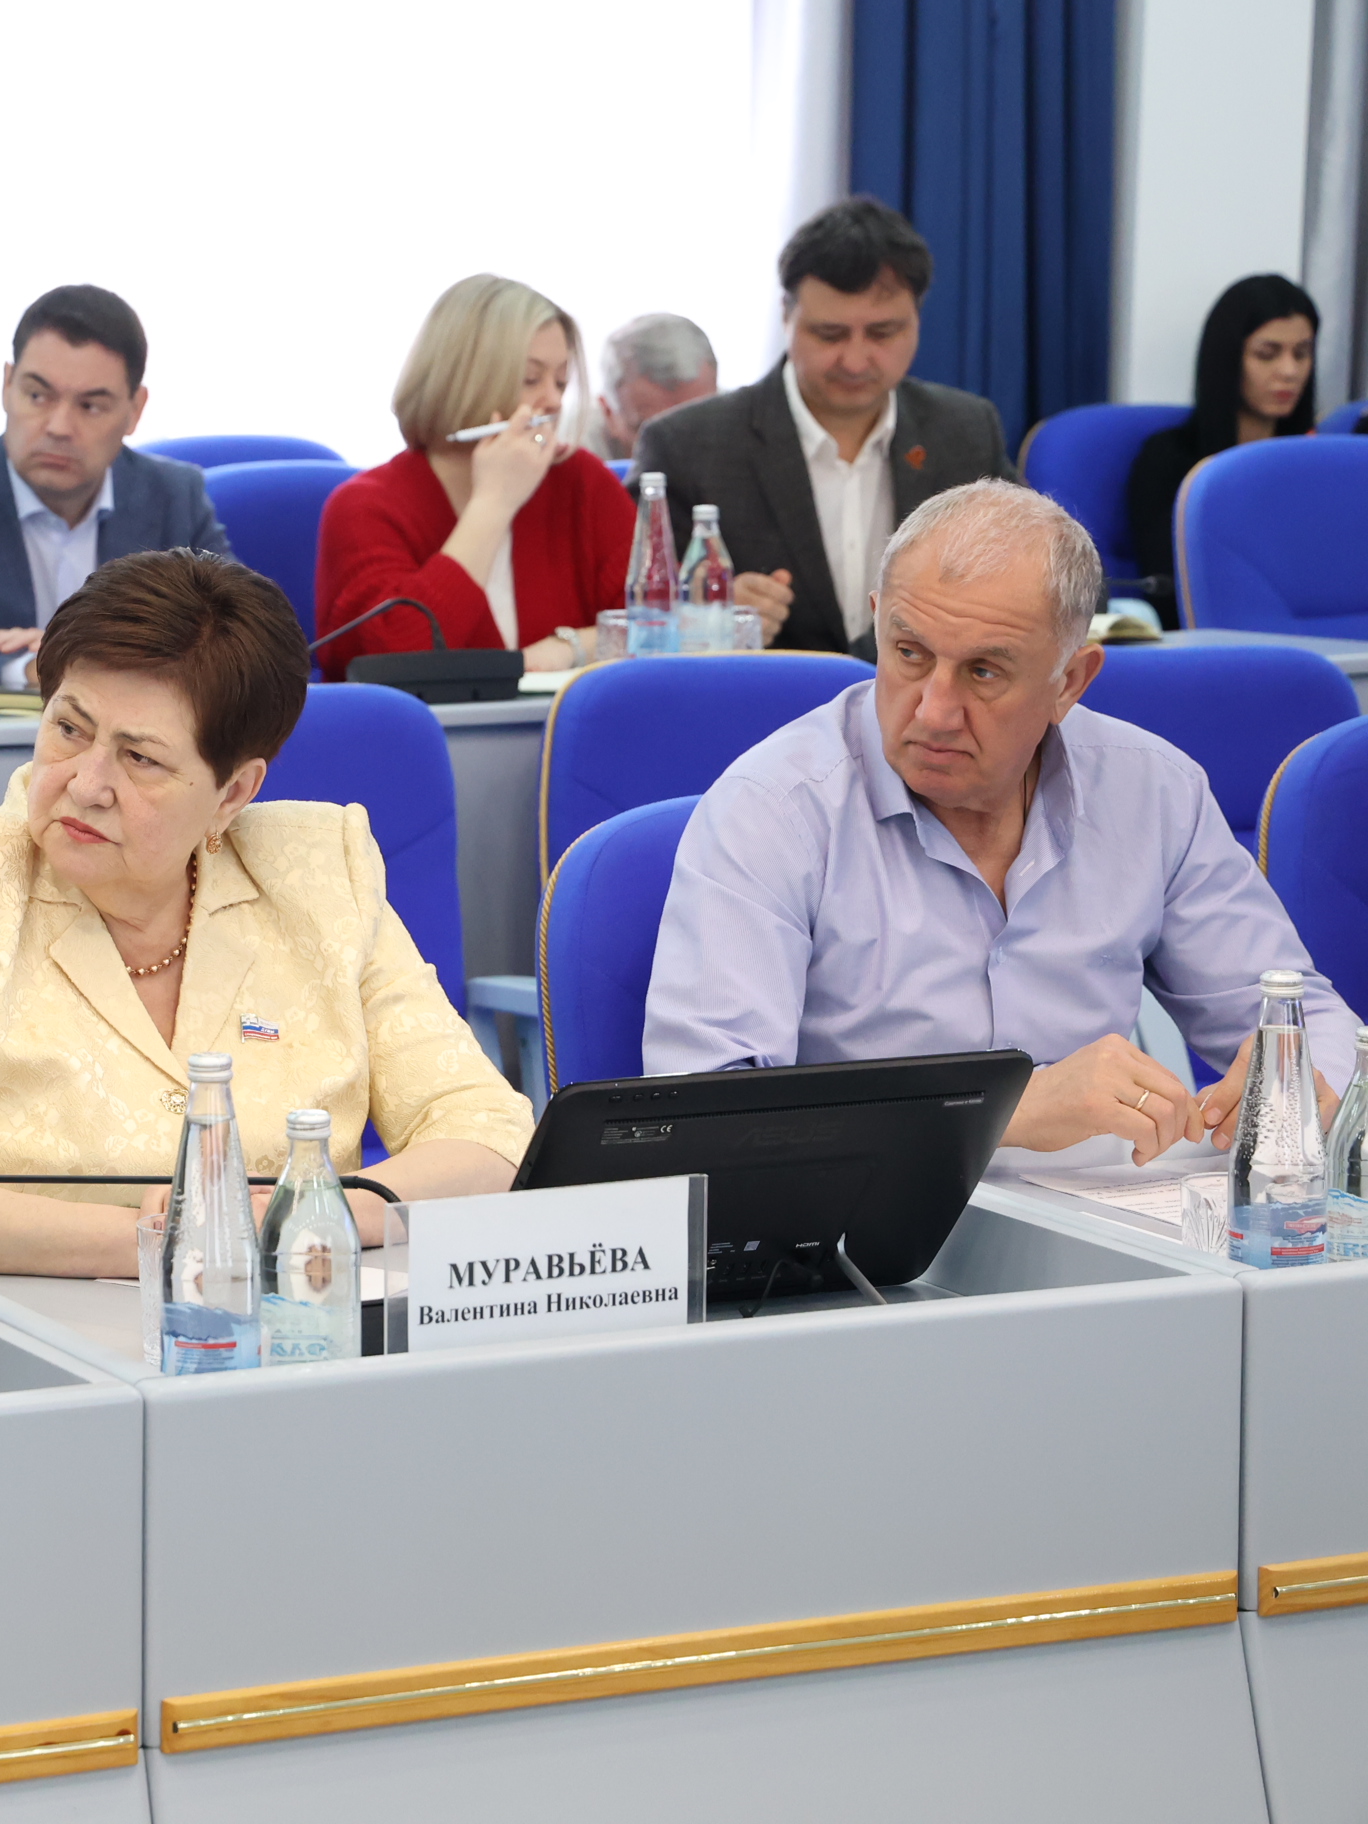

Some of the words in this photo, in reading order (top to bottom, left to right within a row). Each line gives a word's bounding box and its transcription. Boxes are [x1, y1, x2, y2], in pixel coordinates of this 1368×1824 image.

[733, 1121, 844, 1147] ASUS
[447, 1242, 652, 1289] МУРАВЬЁВА
[418, 1300, 539, 1326] Валентина
[545, 1286, 680, 1314] Николаевна
